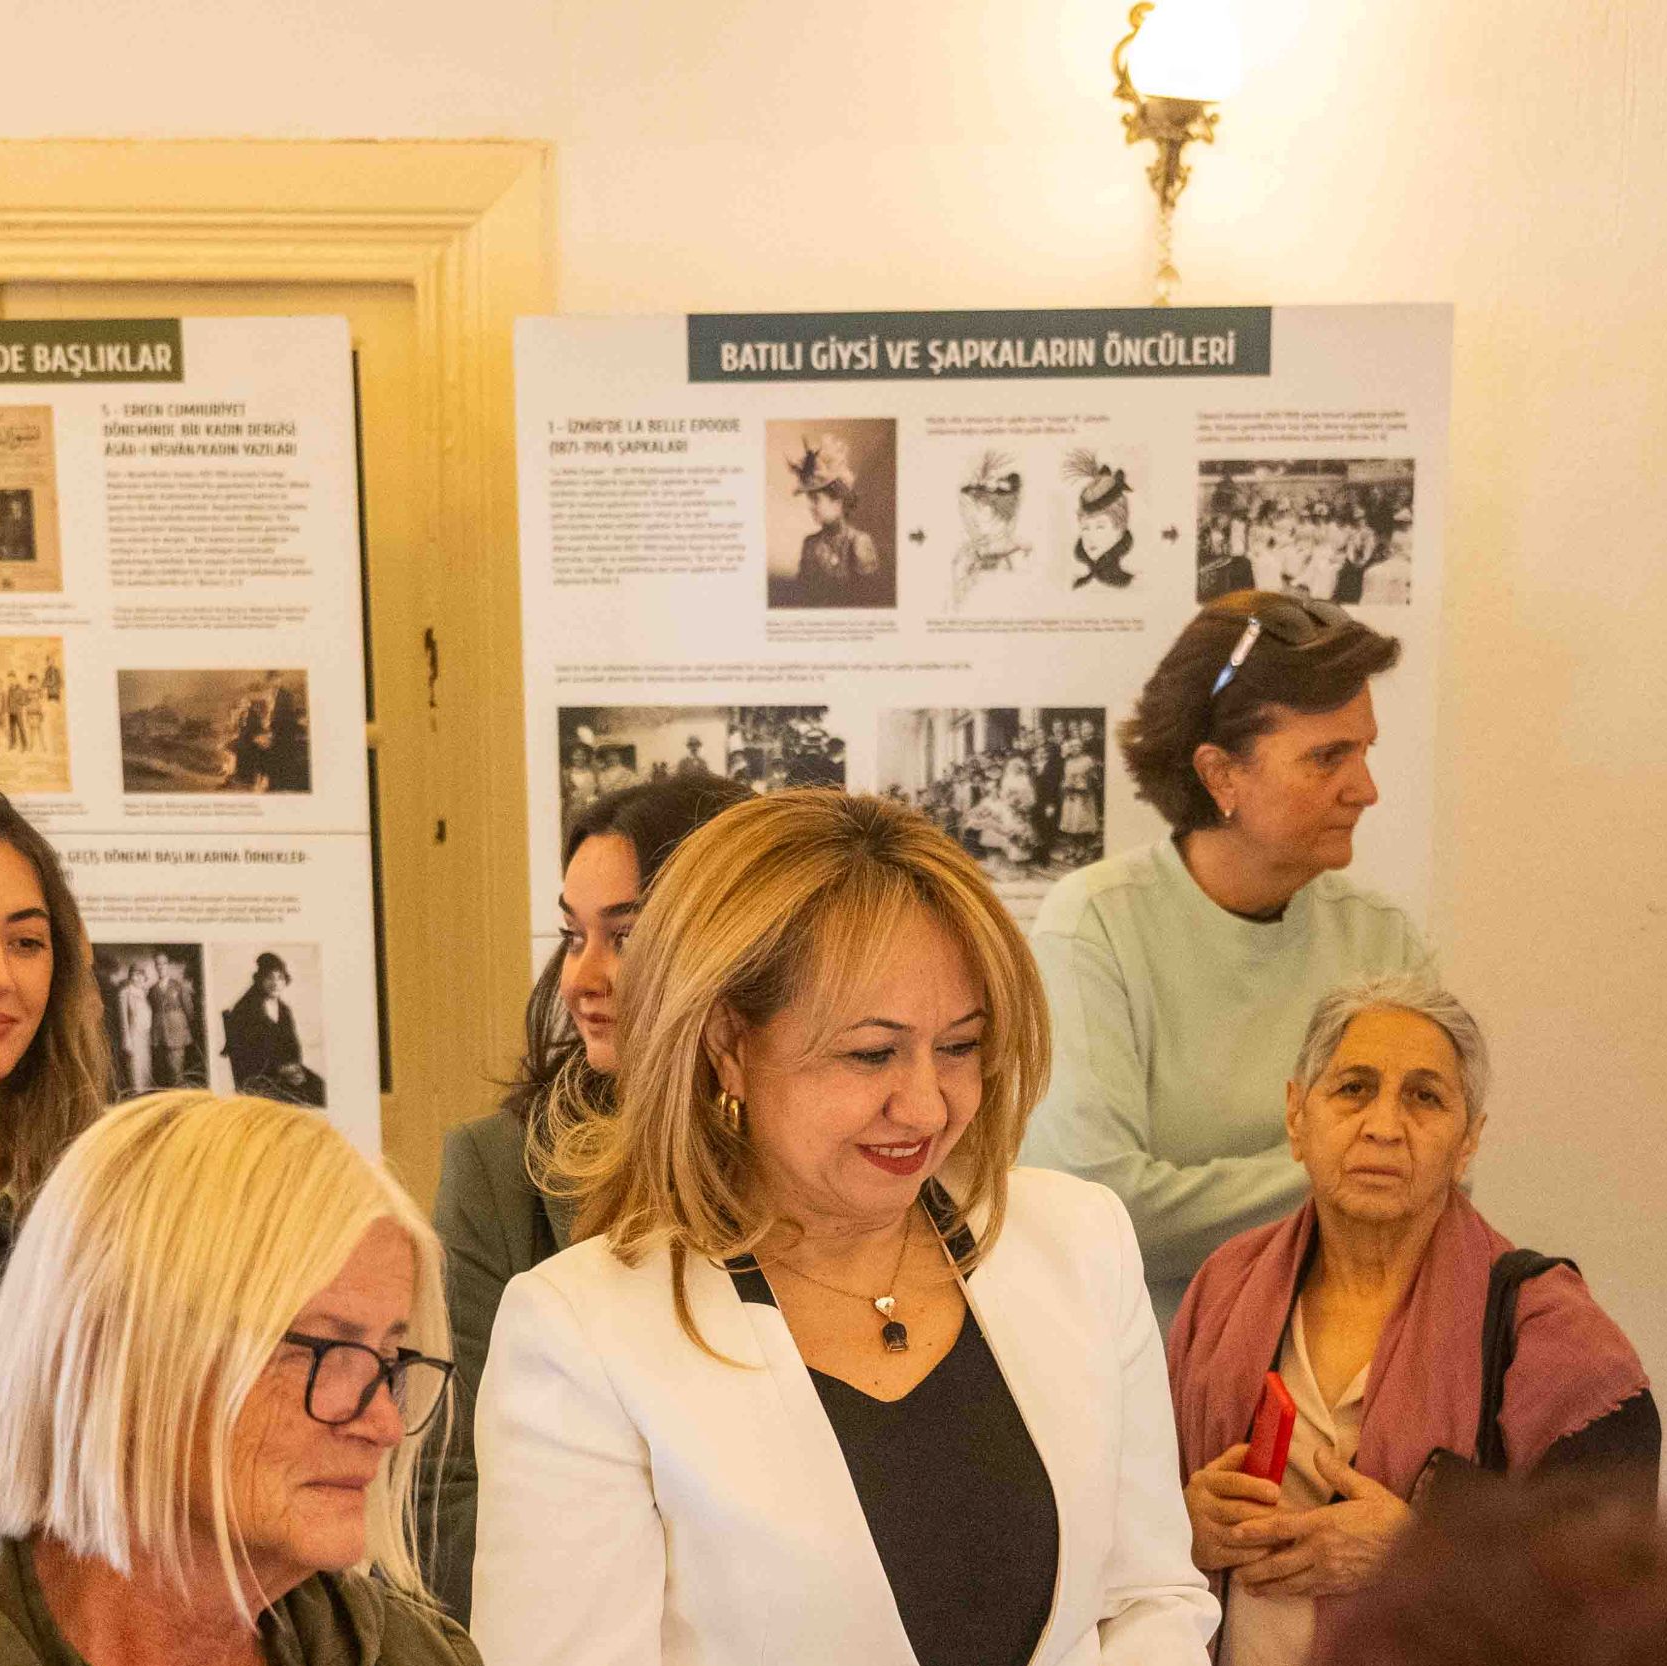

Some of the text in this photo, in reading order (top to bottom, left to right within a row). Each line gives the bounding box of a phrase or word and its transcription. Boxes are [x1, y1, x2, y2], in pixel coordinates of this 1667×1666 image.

[33, 342, 173, 379] BAŞLIKLAR
[720, 330, 1236, 376] BATILI GİYSİ VE ŞAPKALARIN ÖNCÜLERİ
[628, 419, 643, 433] LA
[647, 419, 685, 433] BELLE
[618, 440, 689, 456] ŞAPKALARI
